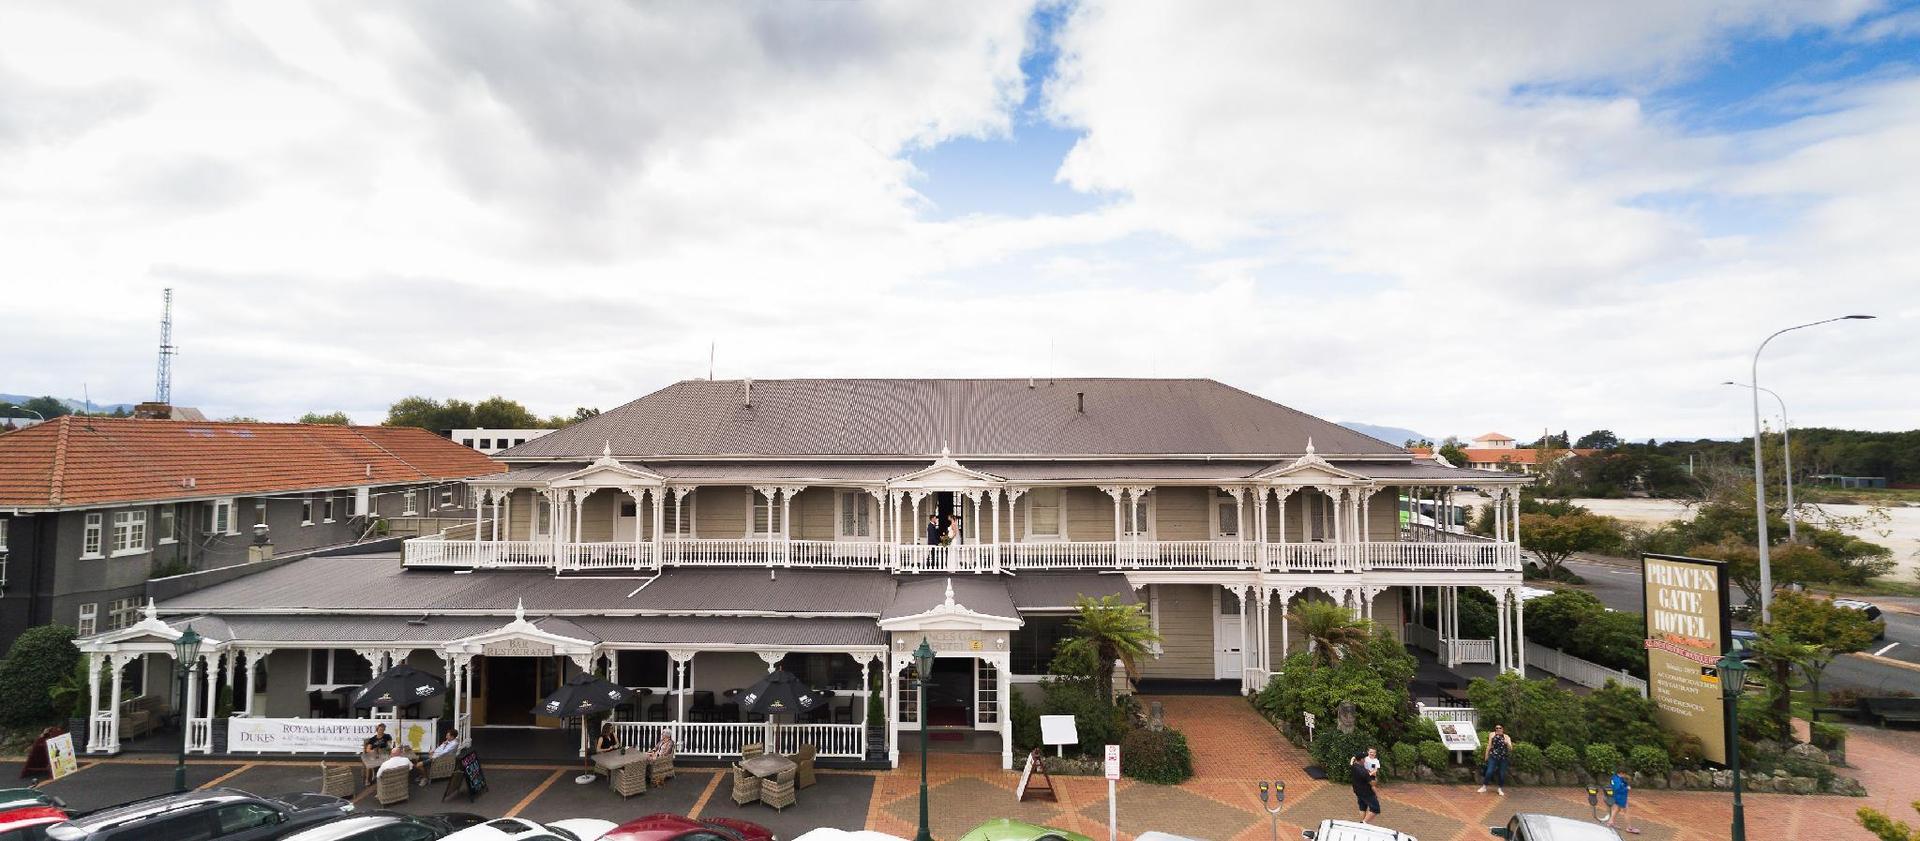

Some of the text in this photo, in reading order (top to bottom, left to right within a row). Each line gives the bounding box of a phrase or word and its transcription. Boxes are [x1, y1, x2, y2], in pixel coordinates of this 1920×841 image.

[1648, 563, 1716, 591] PRINCES
[1659, 588, 1702, 614] GATE
[1655, 610, 1710, 639] HOTEL
[510, 640, 529, 648] BAR
[1657, 679, 1699, 695] RESTAURANT
[1657, 686, 1671, 696] BAR
[283, 724, 315, 734] ROYAL
[318, 724, 350, 735] HAPPY
